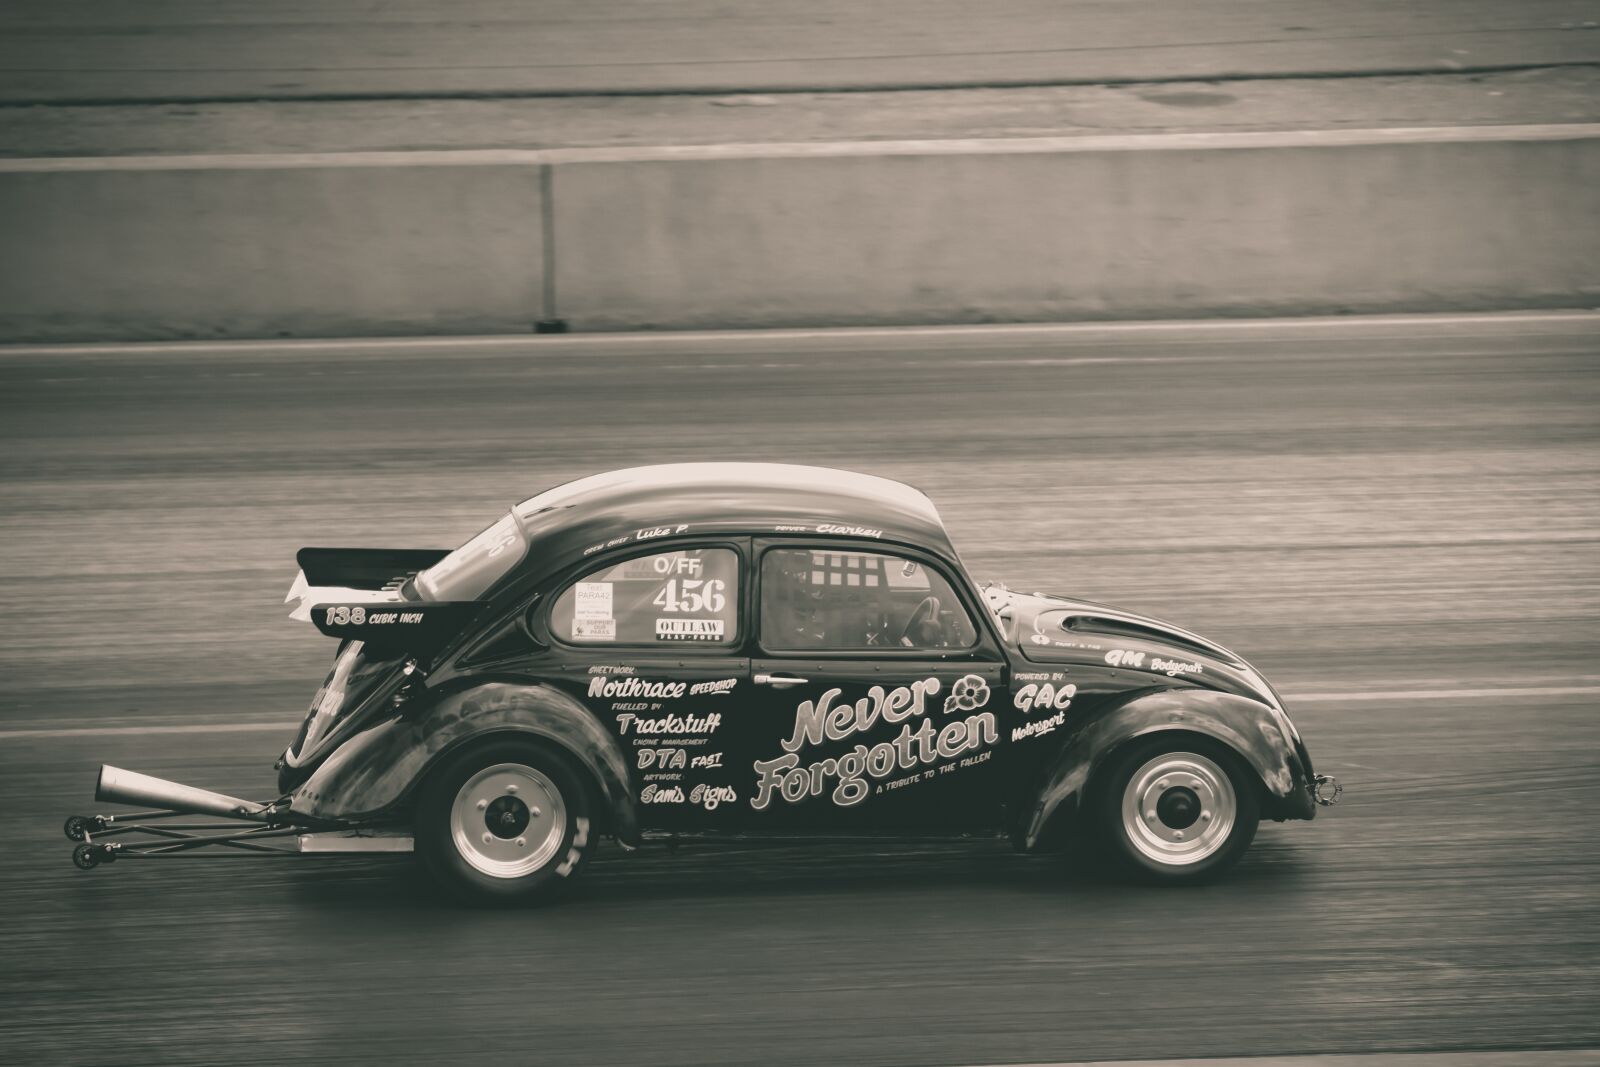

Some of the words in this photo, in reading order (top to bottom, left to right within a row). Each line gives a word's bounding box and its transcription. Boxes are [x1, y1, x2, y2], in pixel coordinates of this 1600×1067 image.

[636, 527, 671, 540] Luke
[815, 523, 884, 539] Clarkey
[653, 556, 701, 576] O/FF
[653, 578, 726, 613] 456
[326, 606, 366, 626] 138
[368, 612, 397, 625] CUBIC
[399, 612, 424, 624] INCH
[660, 621, 718, 633] OUTLAW
[587, 676, 687, 698] Northrace
[689, 678, 738, 696] SPEEDSHOP
[1014, 672, 1050, 682] POWERED
[611, 703, 649, 711] FUELLED
[1013, 683, 1077, 713] GAC
[616, 713, 722, 735] Trackstuff
[780, 677, 941, 752] Never
[1011, 710, 1066, 743] Motorsport
[632, 738, 660, 746] ENGINE
[637, 748, 687, 769] DTA
[690, 752, 723, 769] FAST
[750, 711, 999, 810] Forgotten
[876, 784, 884, 795] A
[886, 773, 921, 792] TRIBUTE
[924, 769, 936, 780] TO
[939, 763, 957, 776] THE
[960, 750, 993, 768] FALLEN
